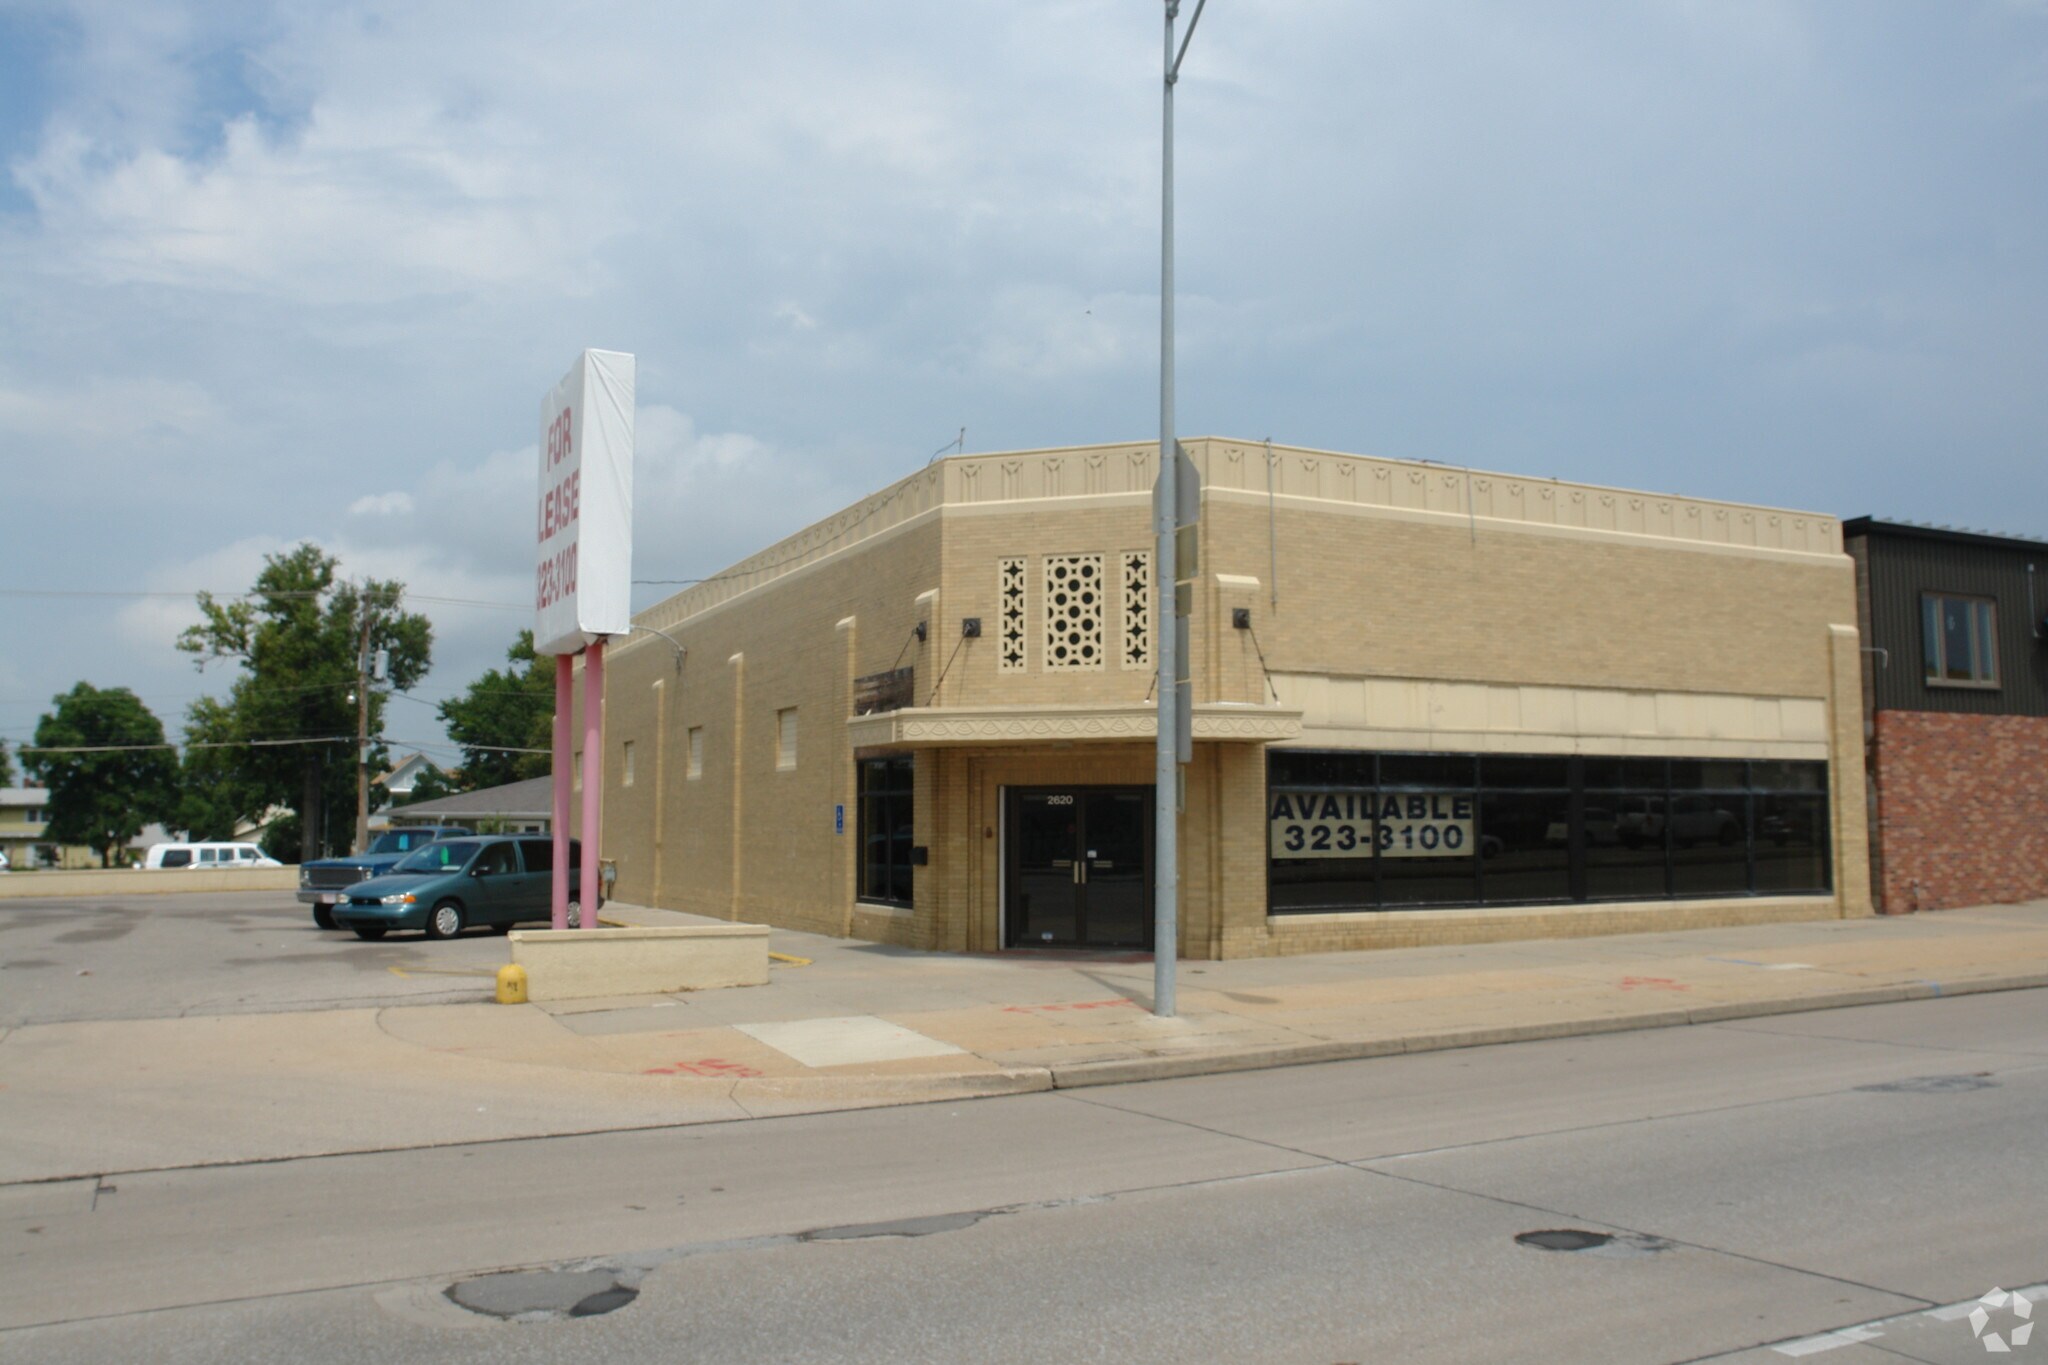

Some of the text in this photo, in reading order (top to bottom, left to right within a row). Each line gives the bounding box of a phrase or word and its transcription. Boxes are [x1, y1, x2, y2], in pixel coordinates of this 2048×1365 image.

[547, 406, 571, 472] FOR
[538, 468, 579, 544] LEASE
[1047, 795, 1073, 805] 2620
[1271, 795, 1472, 819] AVAILABLE
[1285, 825, 1463, 850] 323-3100
